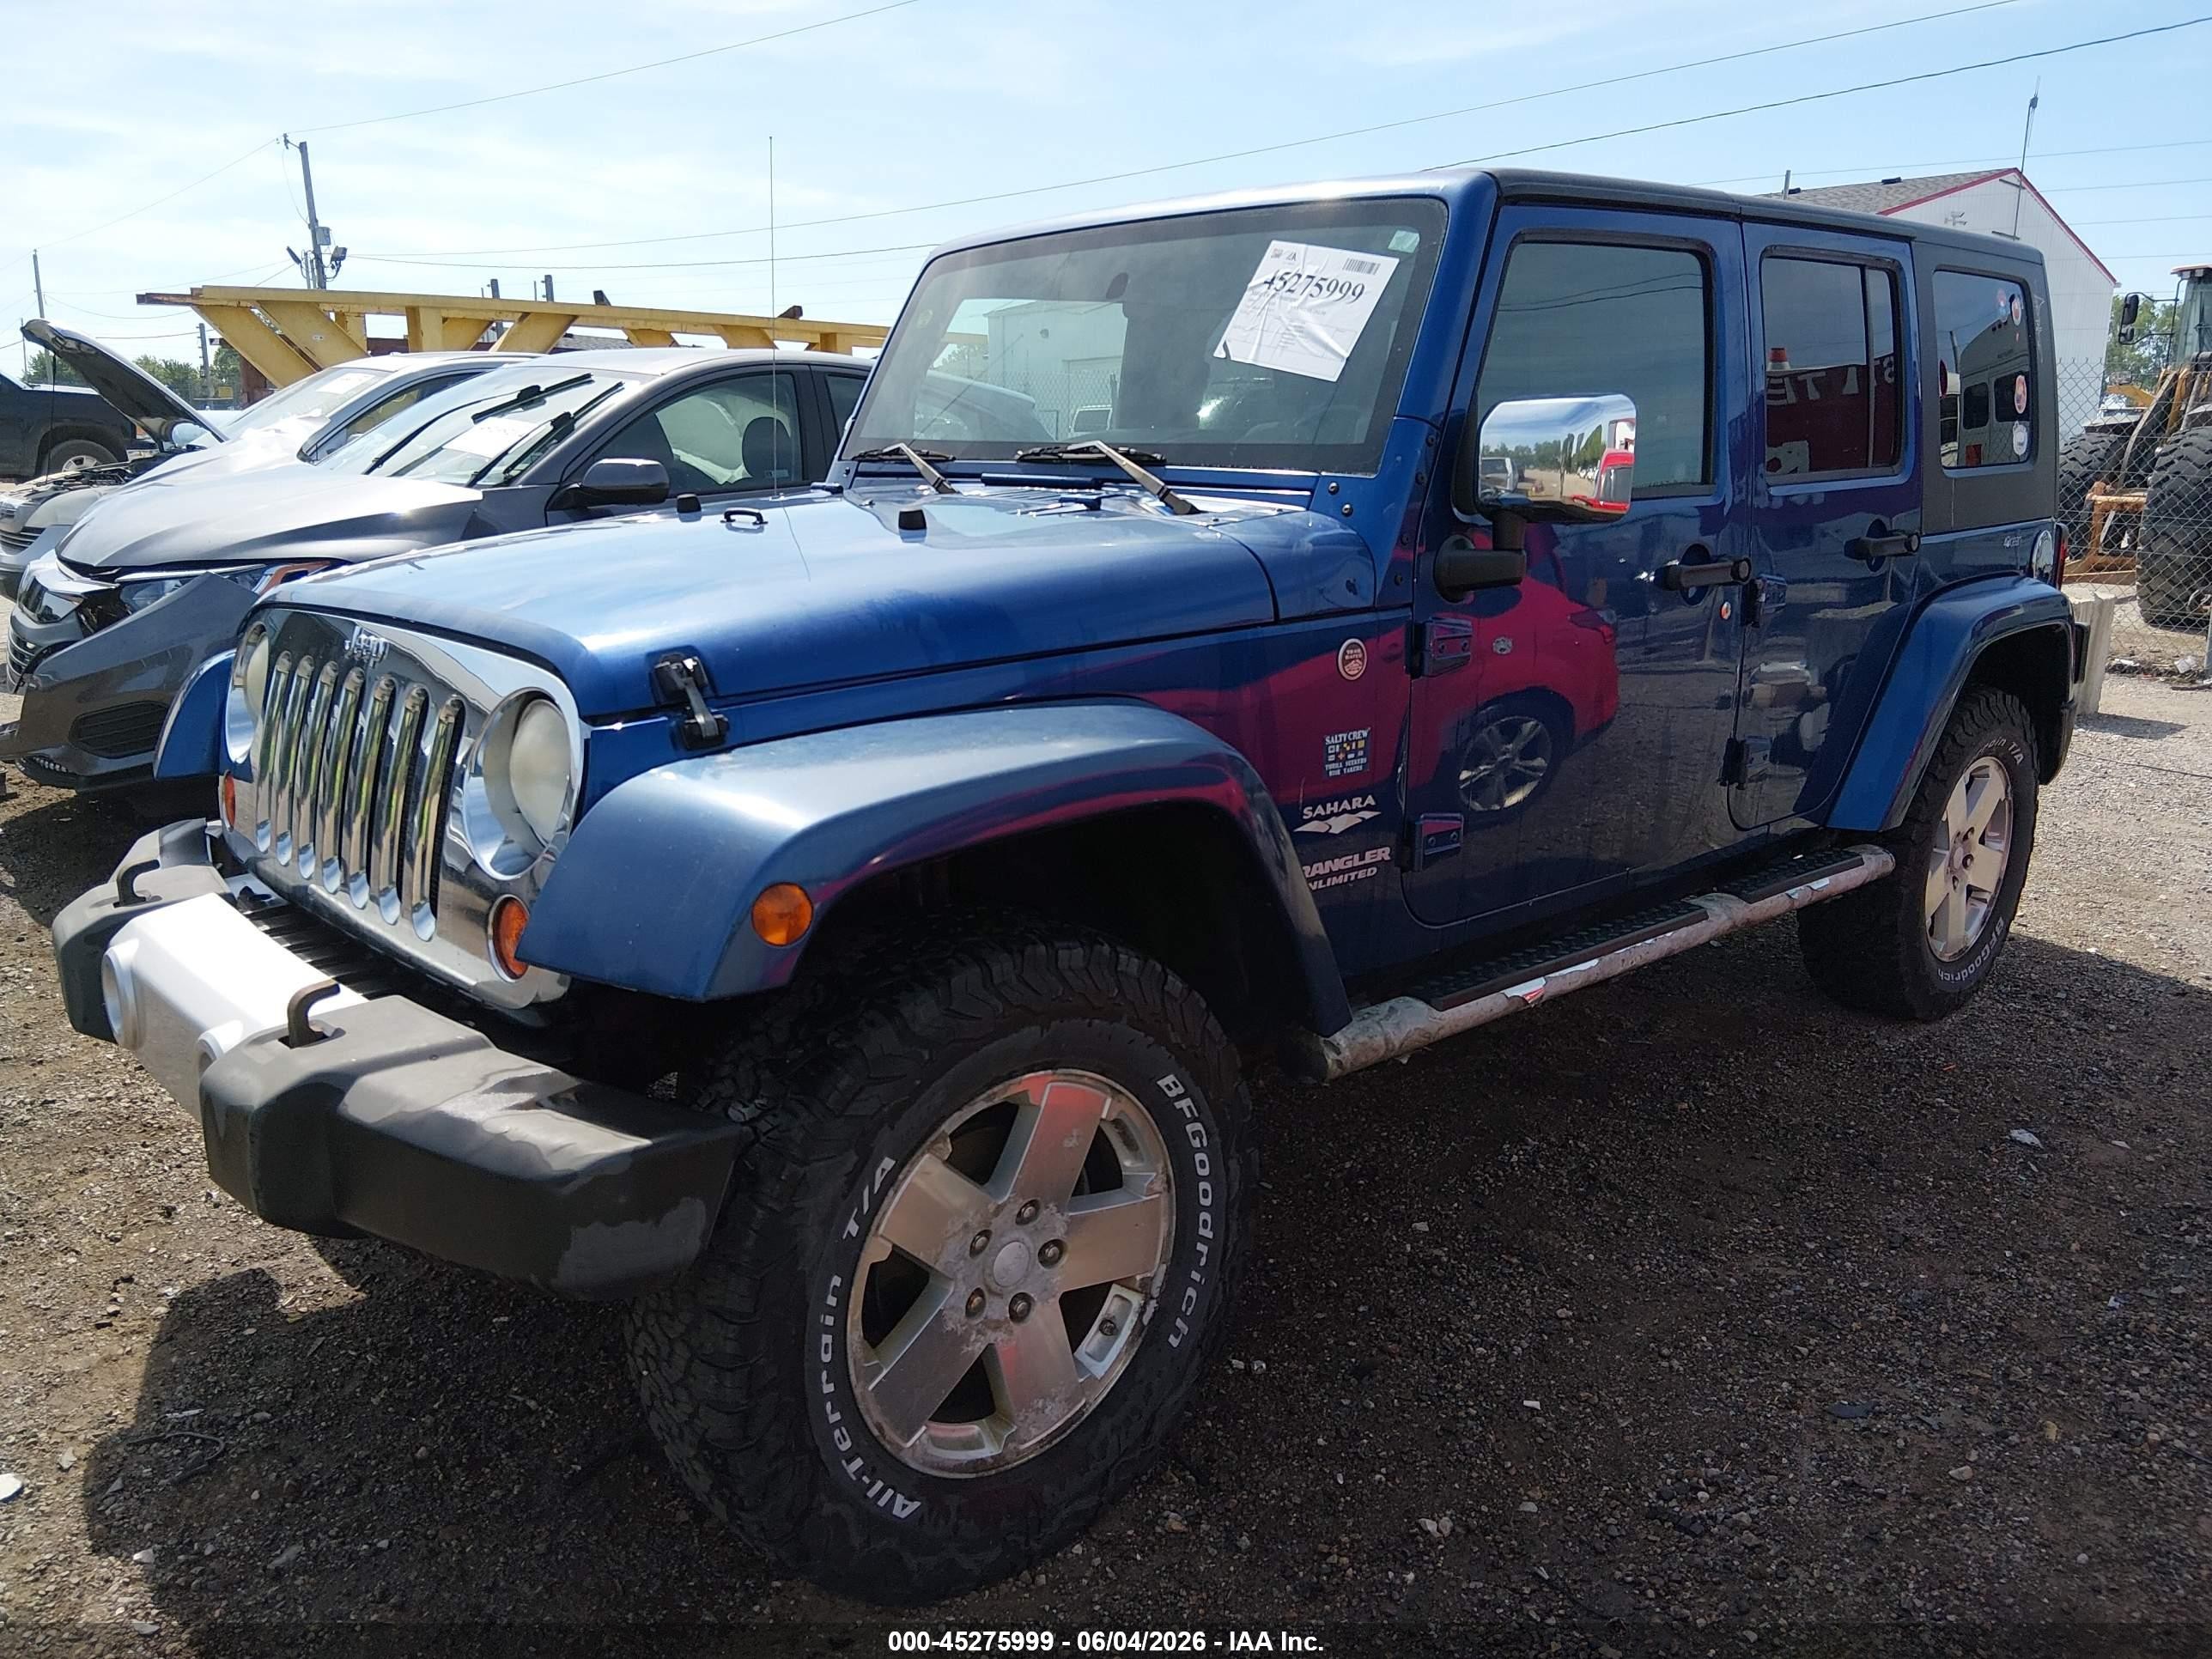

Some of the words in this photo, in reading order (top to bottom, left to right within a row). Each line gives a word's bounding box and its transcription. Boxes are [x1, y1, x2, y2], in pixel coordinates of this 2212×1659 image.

[1263, 269, 1365, 304] 45275999
[1325, 733, 1347, 745] SALTY
[1347, 730, 1368, 741] CREW
[1303, 794, 1376, 819] SAHARA
[1302, 847, 1391, 878] RANGLER
[1308, 866, 1378, 890] NLIMITED
[1936, 915, 2004, 982] BFGoodrich
[842, 1156, 897, 1241] T/A
[1155, 1073, 1215, 1350] BFGoodrich
[817, 1273, 923, 1520] All-Terrain
